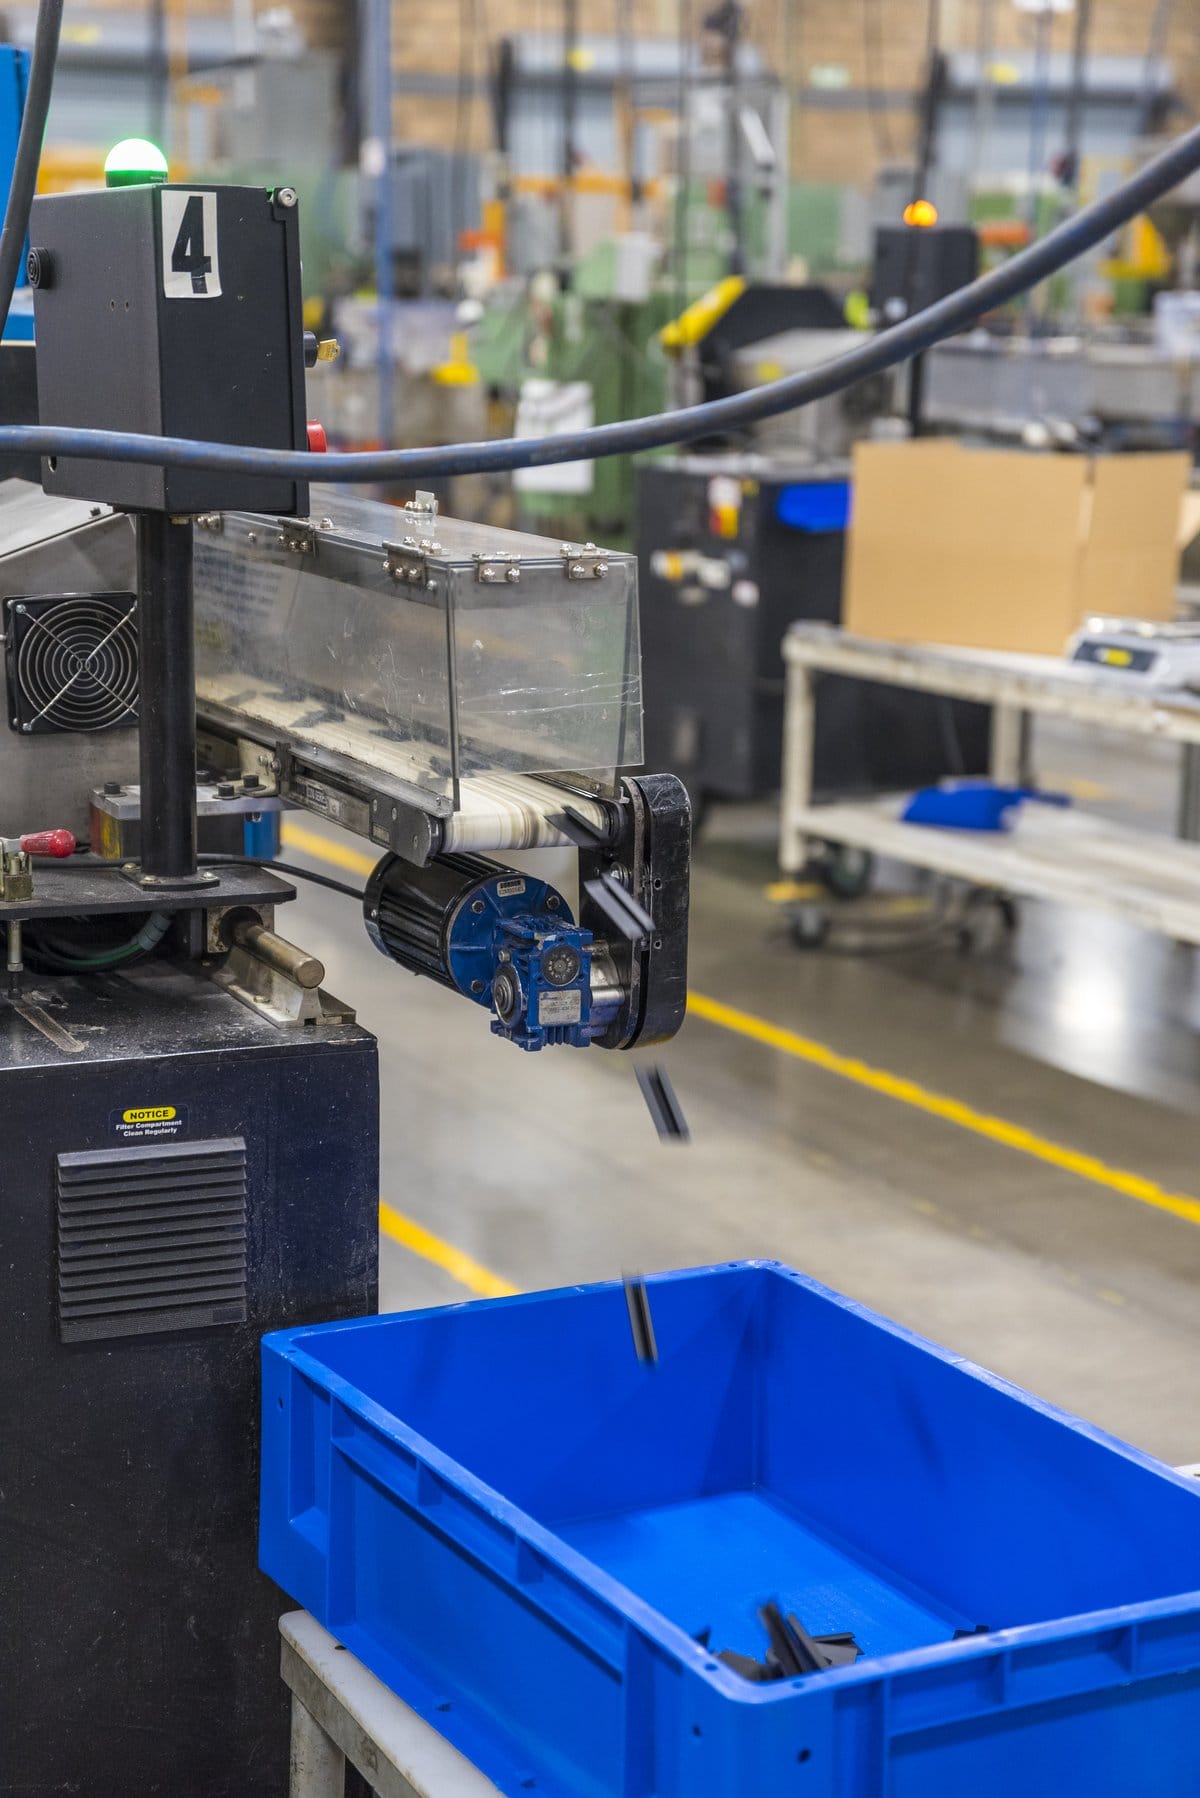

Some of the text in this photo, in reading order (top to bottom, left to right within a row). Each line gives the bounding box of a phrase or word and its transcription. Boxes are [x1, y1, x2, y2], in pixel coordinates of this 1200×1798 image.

[171, 196, 212, 294] 4
[130, 1110, 169, 1119] NOTICE
[115, 1120, 182, 1131] Filter Compartment
[144, 1127, 177, 1136] Regularly
